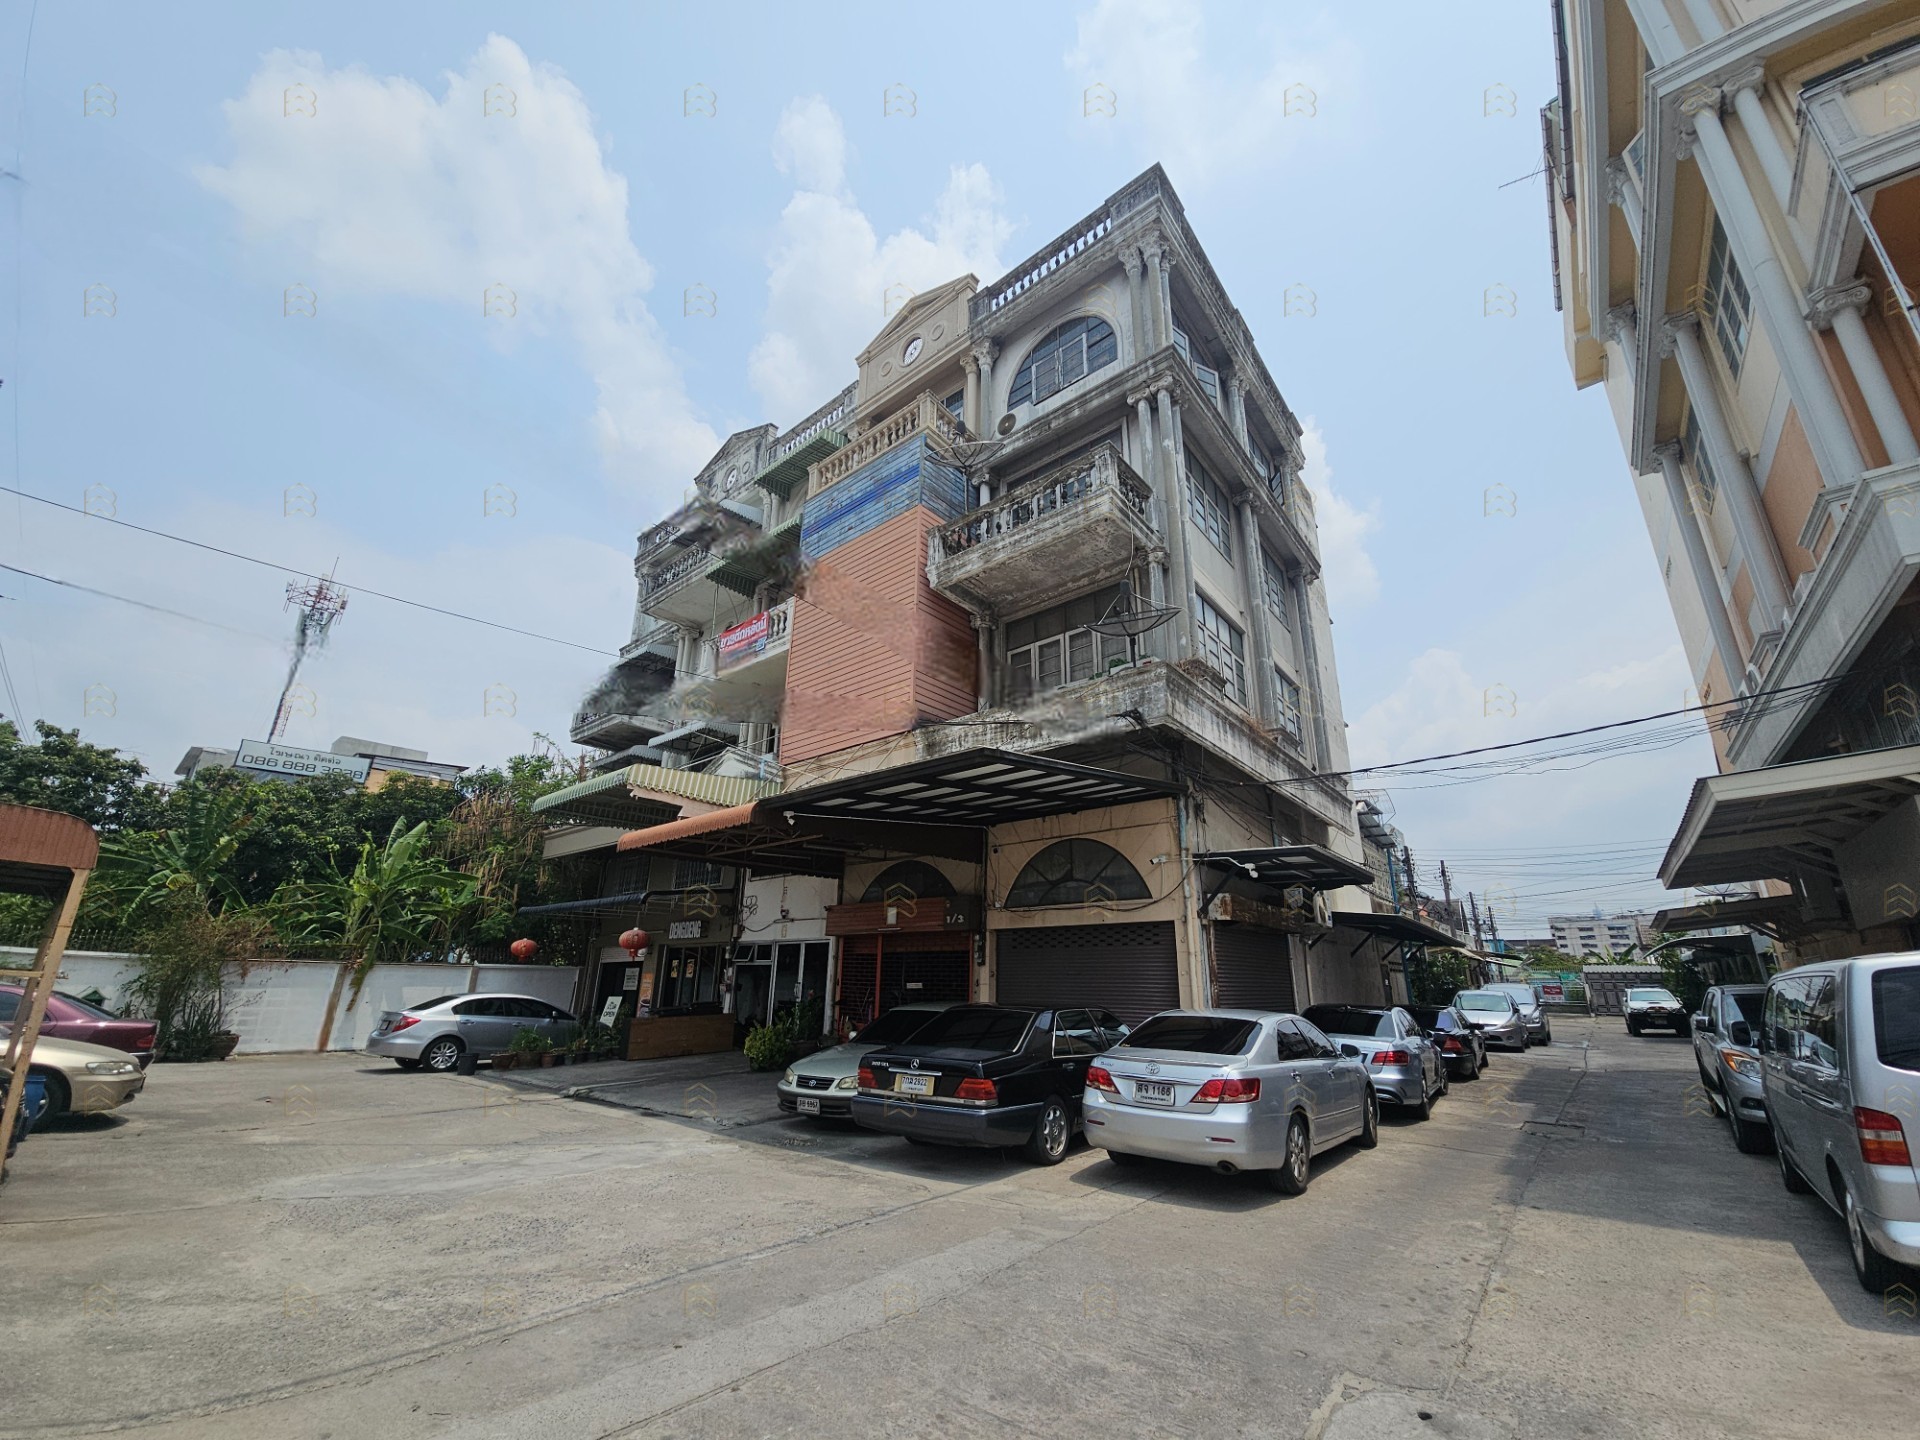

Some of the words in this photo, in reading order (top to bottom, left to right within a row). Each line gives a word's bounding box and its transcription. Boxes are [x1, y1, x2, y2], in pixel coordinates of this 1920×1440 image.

[242, 754, 279, 768] 086
[282, 760, 317, 773] 888
[270, 746, 310, 760] โฆษณา
[314, 753, 341, 765] ติดต่อ
[946, 913, 965, 924] 1/3
[668, 920, 702, 940] DENGDENG
[603, 1010, 615, 1018] OPEN
